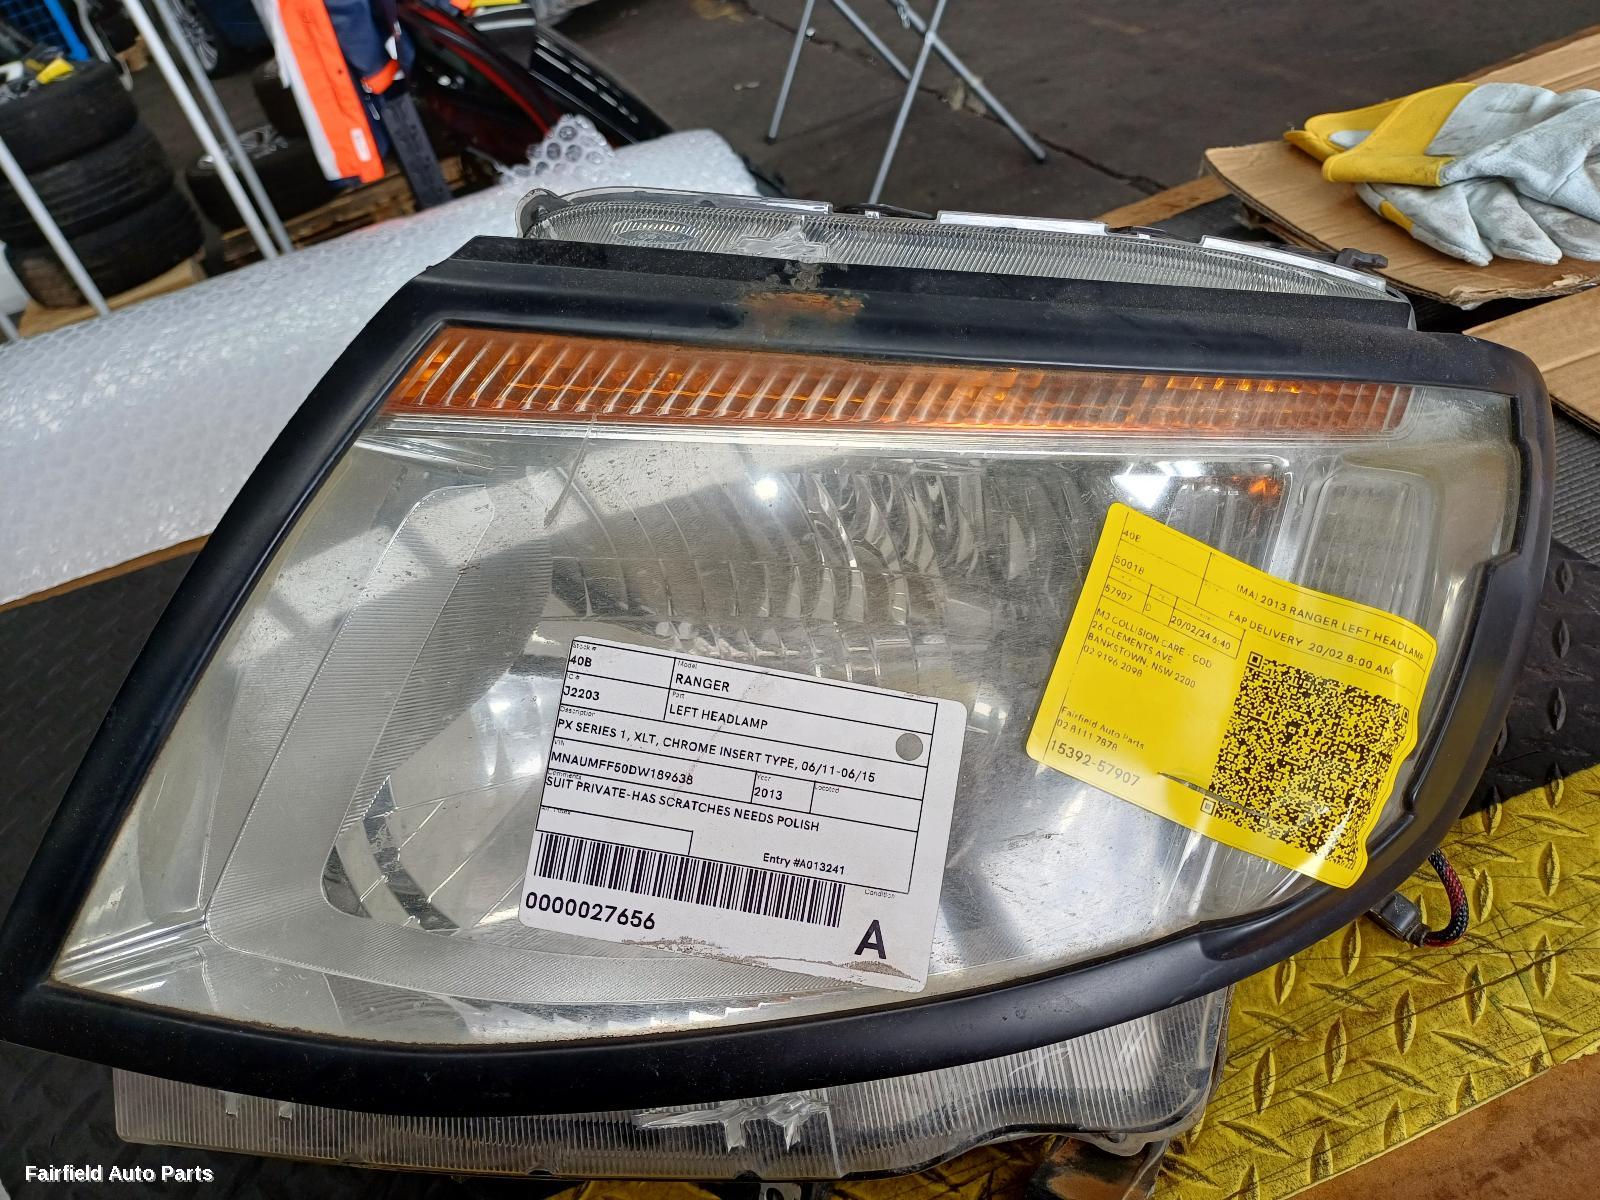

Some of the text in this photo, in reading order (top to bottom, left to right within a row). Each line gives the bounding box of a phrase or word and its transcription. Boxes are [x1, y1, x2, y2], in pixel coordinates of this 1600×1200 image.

[1105, 584, 1133, 601] 57907
[1092, 620, 1173, 664] 26 CLEMENTS AVE
[1112, 616, 1160, 643] COLLISION
[1161, 640, 1185, 656] CARE
[1192, 654, 1213, 668] COD
[1171, 616, 1211, 640] 20/02/24
[1212, 636, 1231, 650] 6:40
[1228, 610, 1248, 625] FAP
[1249, 621, 1303, 647] DELIVERY
[1308, 642, 1343, 660] 20/02
[1347, 654, 1373, 670] 8:00
[1375, 664, 1394, 676] AM
[1260, 595, 1287, 612] 2013
[1290, 606, 1338, 628] RANGER
[1342, 622, 1370, 638] LEFT
[1374, 632, 1424, 660] HEADLAMP
[570, 655, 592, 667] 40B
[1083, 645, 1143, 677] 02 9196 2098
[1151, 662, 1174, 677] NSW
[1174, 672, 1196, 688] 2200
[563, 686, 600, 701] J2203
[675, 673, 730, 692] RANGER
[669, 704, 768, 730] LEFT HEADLAMP
[1061, 706, 1145, 750] Fairfield Auto Parts
[558, 719, 876, 783] PX SERIES 1, XLT, CHROME INSERT TYPE, 06/11-06/15
[1057, 718, 1069, 729] 02
[1095, 735, 1118, 751] 7878
[551, 751, 694, 785] MNAUMFF50DW189638
[1051, 739, 1141, 787] 15392-57907
[546, 776, 820, 832] SUIT PRIVATE-HAS SCRATCHES NEEDS POLISH
[754, 787, 783, 801] 2013
[763, 853, 845, 875] Entry #A013241
[525, 892, 656, 930] 0000027656
[854, 919, 887, 960] A
